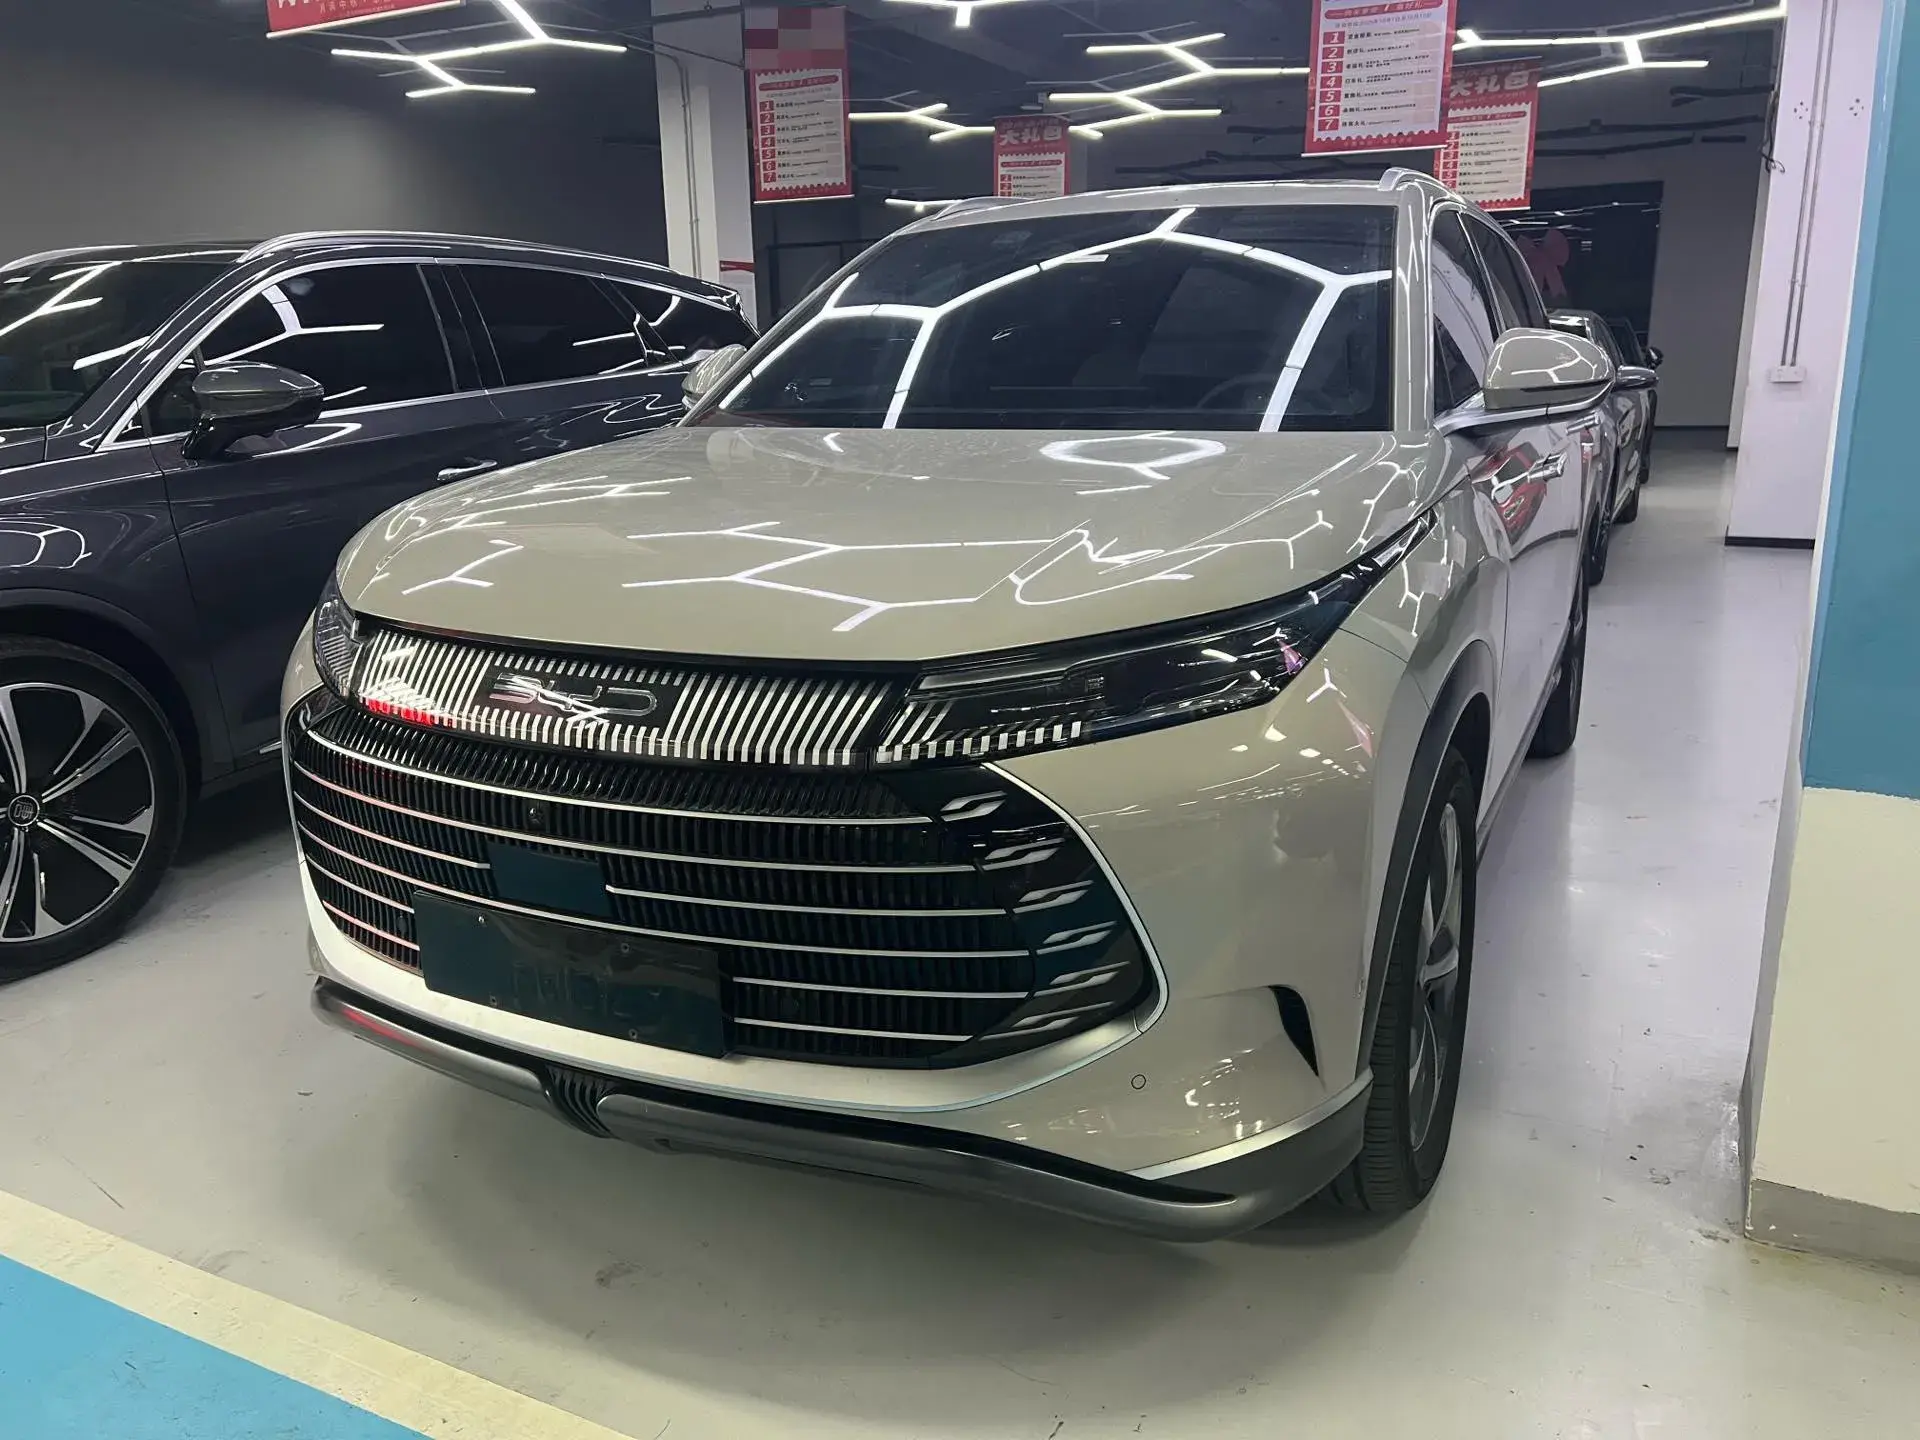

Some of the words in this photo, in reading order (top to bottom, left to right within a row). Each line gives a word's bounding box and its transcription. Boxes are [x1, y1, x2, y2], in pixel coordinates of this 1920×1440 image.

[1330, 32, 1339, 43] 1
[1328, 48, 1338, 57] 2
[1327, 62, 1337, 72] 3
[1327, 77, 1336, 88] 4
[1450, 70, 1530, 99] 大礼包
[1325, 91, 1335, 101] 5
[1325, 106, 1334, 116] 6
[1325, 120, 1334, 130] 7
[490, 672, 658, 717] BYD
